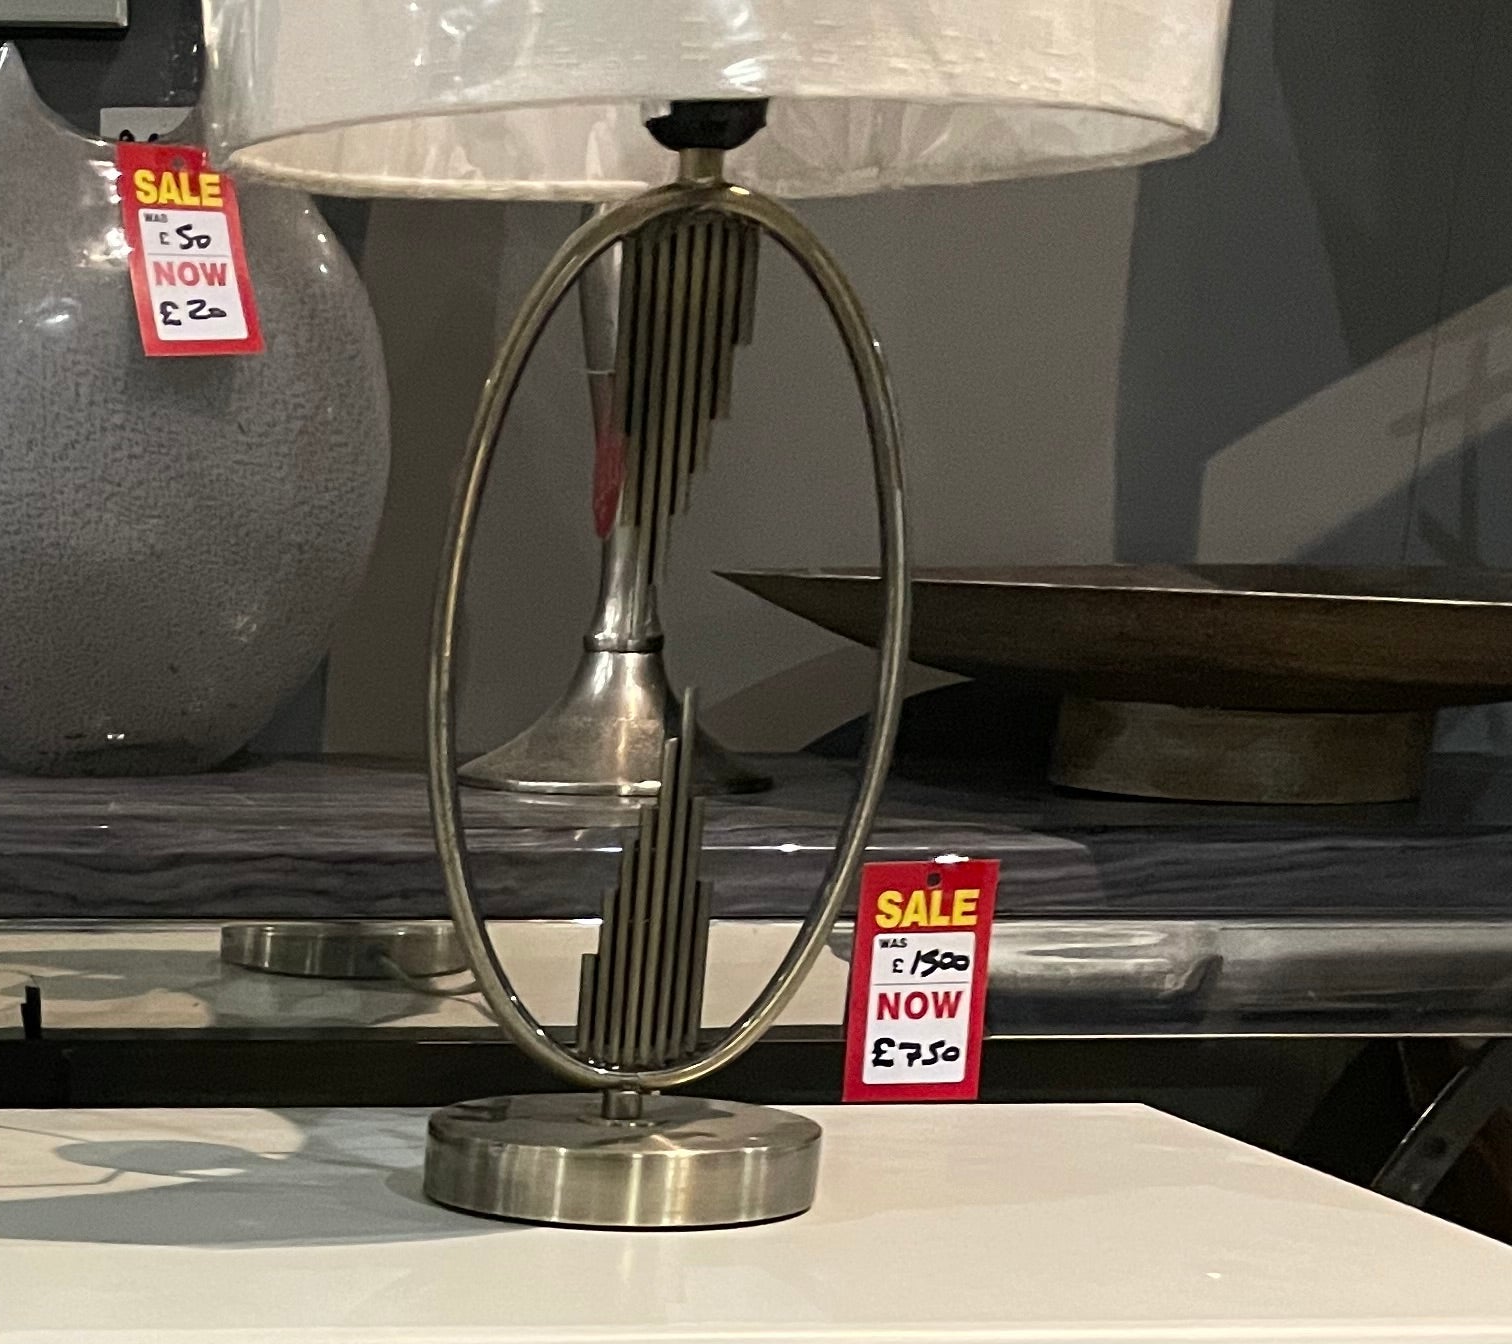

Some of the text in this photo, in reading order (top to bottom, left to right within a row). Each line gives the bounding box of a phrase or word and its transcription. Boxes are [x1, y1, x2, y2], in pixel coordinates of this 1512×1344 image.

[133, 169, 224, 207] SALE
[152, 260, 227, 287] NOW
[875, 889, 980, 928] SALE
[878, 938, 908, 949] WAS
[876, 991, 964, 1021] NOW
[871, 1037, 961, 1068] £750
